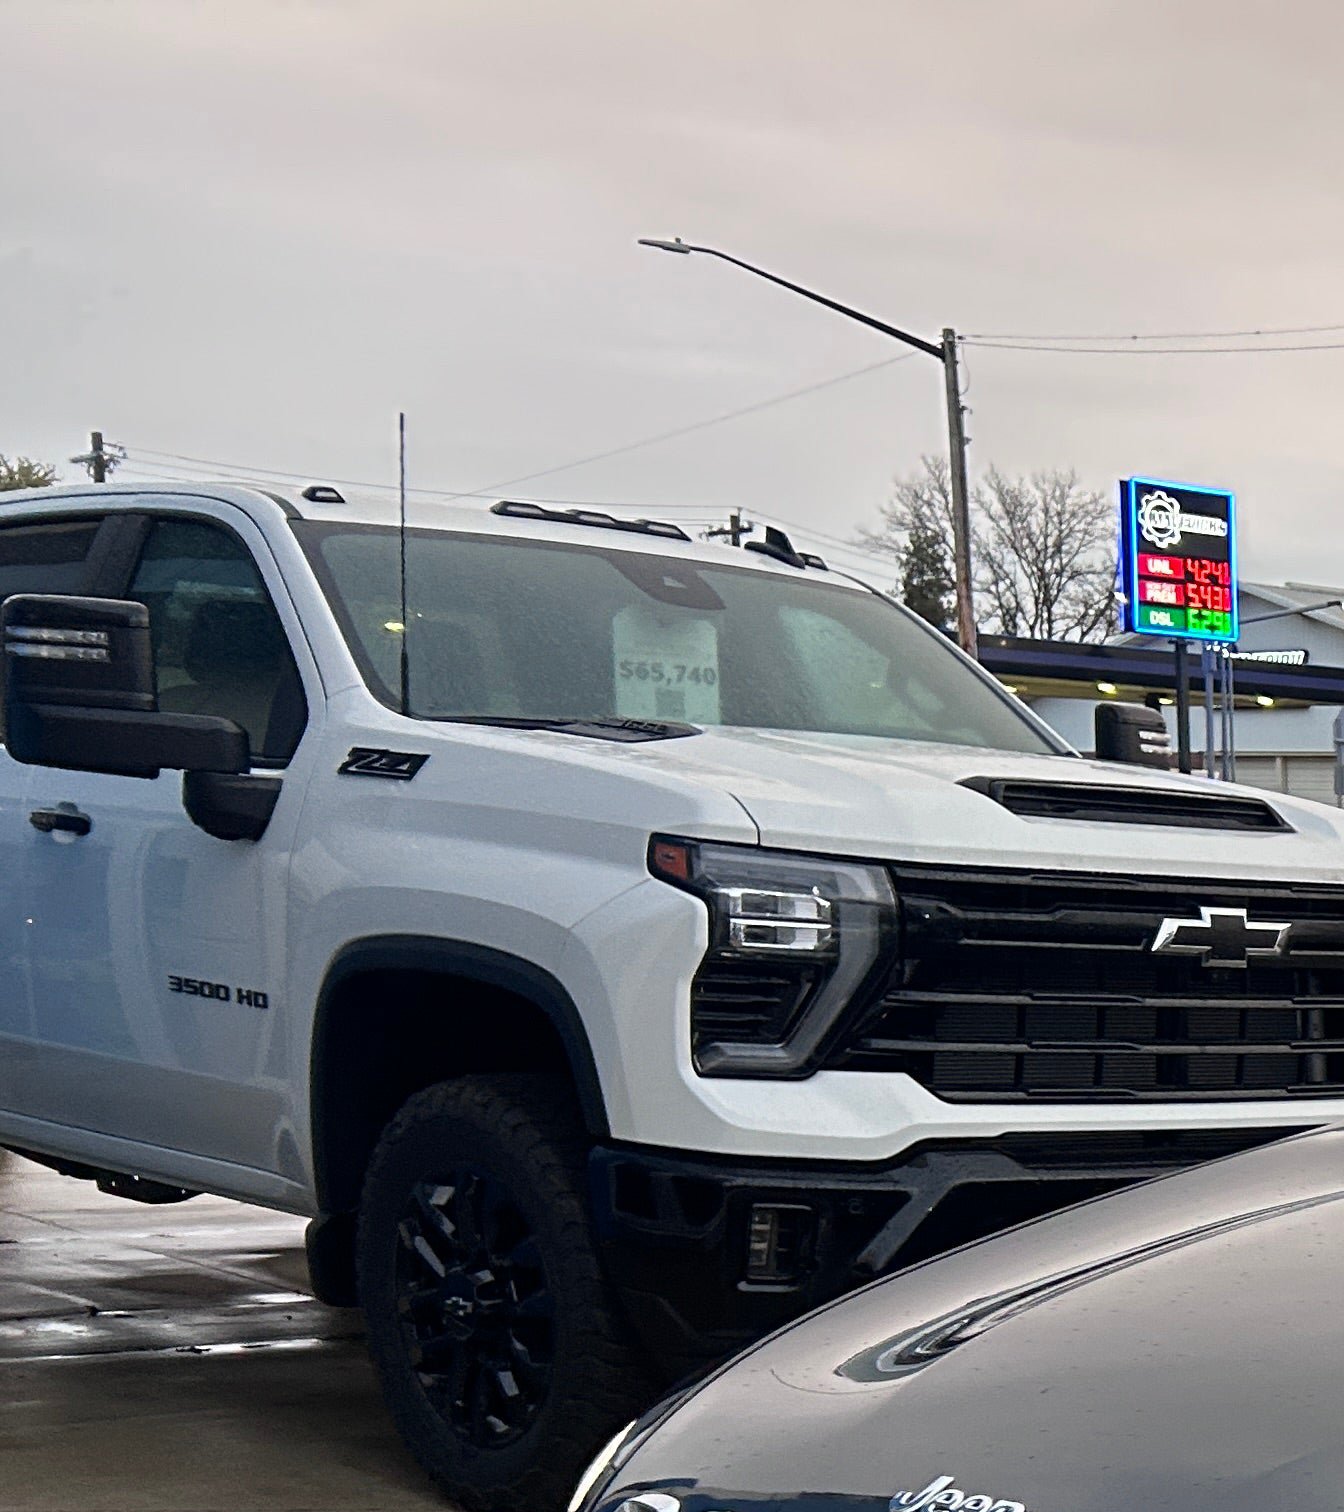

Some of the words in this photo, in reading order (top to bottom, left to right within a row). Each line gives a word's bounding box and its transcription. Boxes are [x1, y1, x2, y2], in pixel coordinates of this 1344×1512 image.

[1147, 558, 1174, 575] UNL
[1149, 611, 1175, 626] DSL
[620, 660, 717, 686] $65,740
[168, 975, 231, 1002] 3500
[236, 987, 269, 1009] HD
